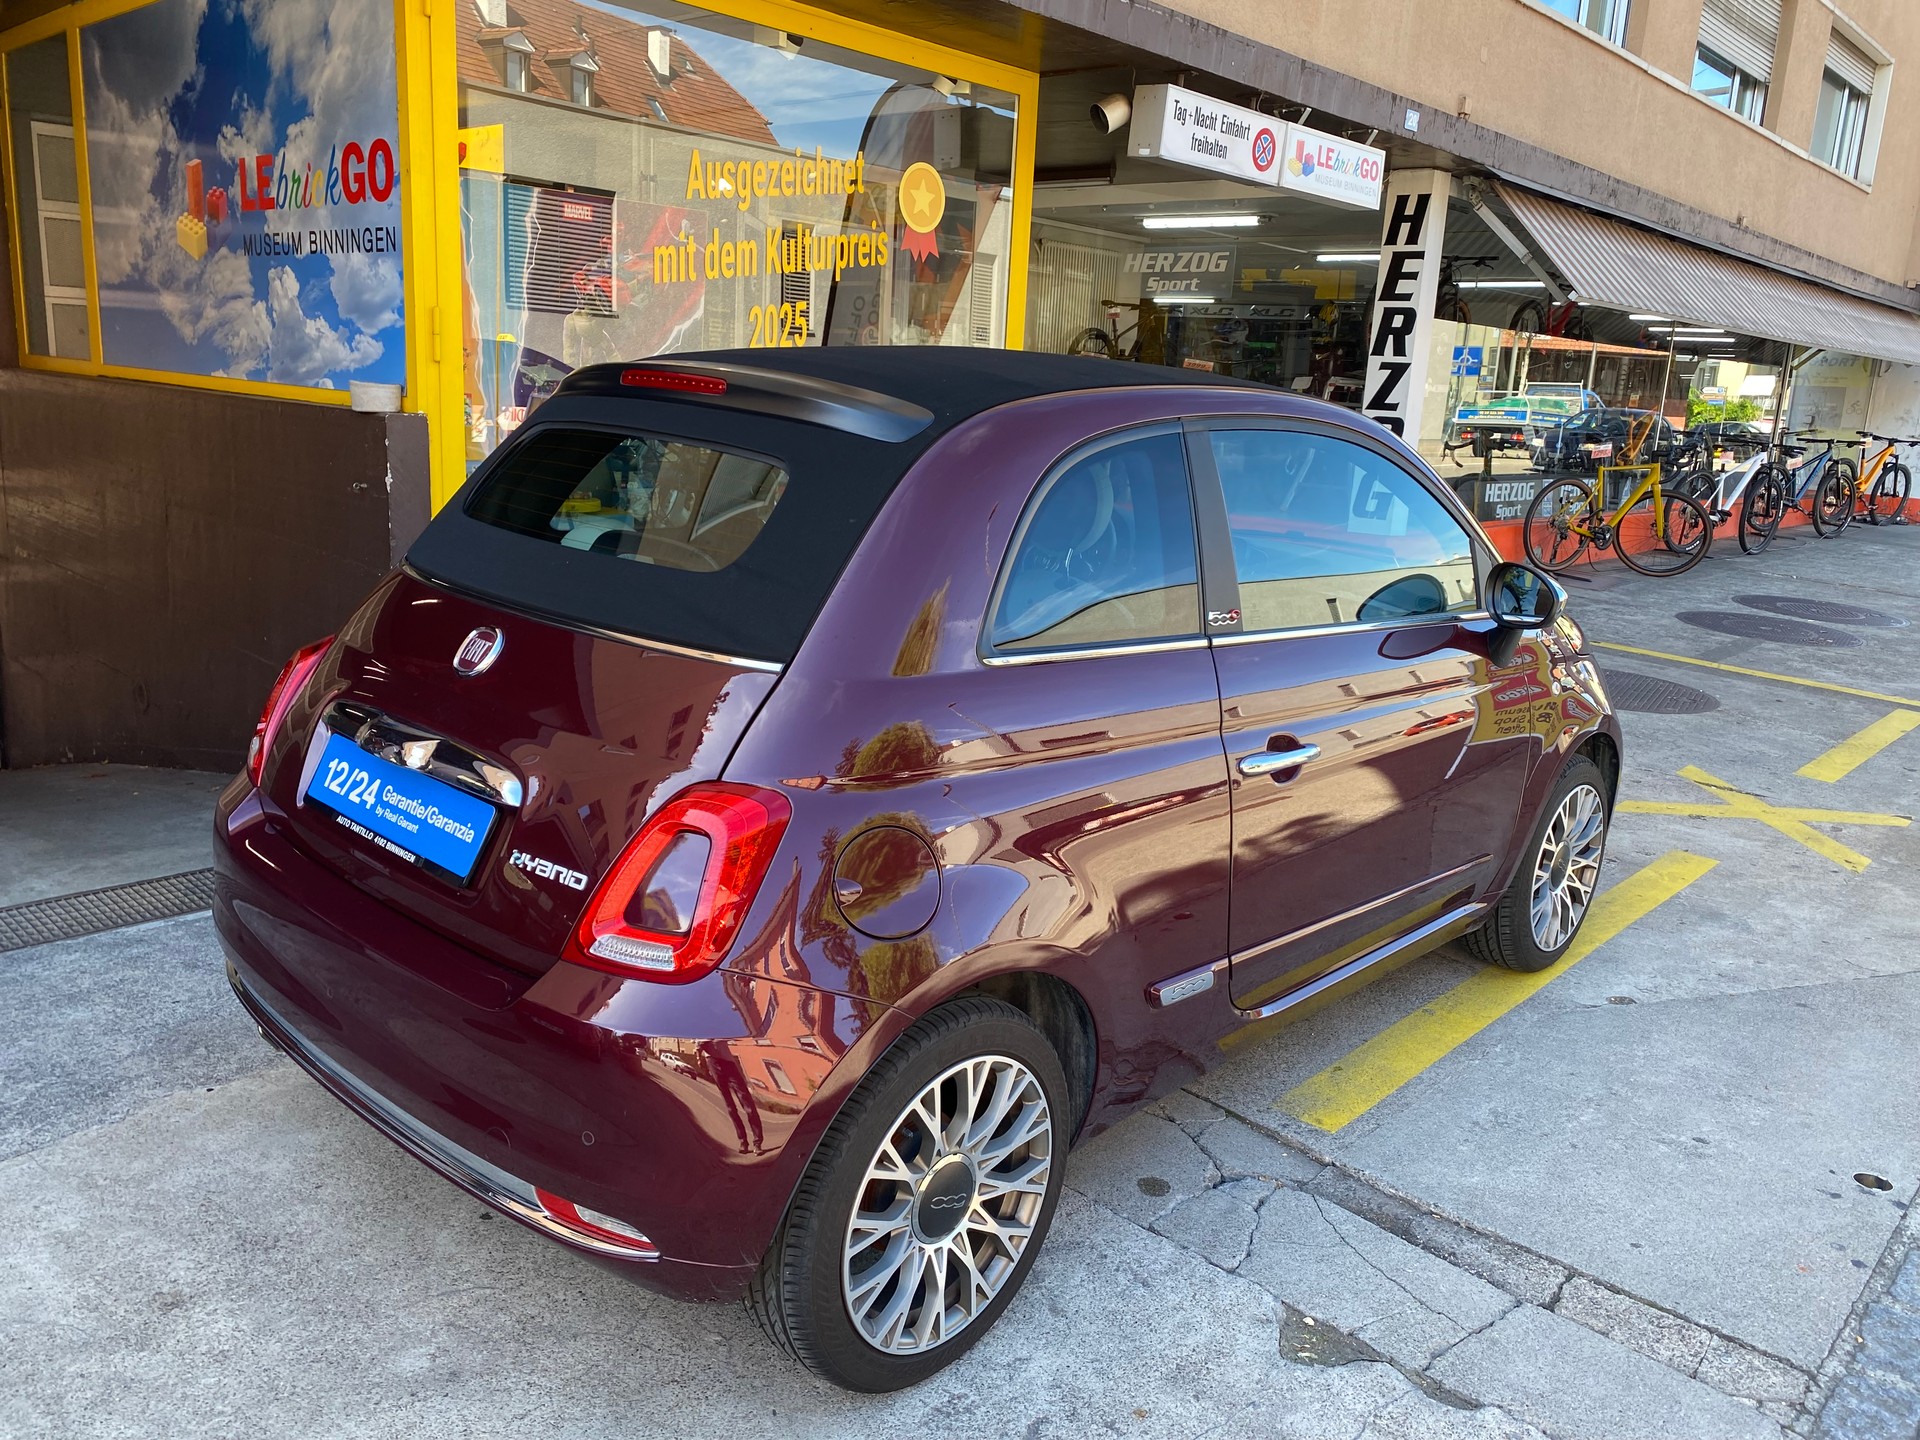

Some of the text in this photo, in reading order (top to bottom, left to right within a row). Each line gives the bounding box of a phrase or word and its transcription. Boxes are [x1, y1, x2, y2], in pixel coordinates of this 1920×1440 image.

[1173, 99, 1187, 126] Tag
[1193, 105, 1218, 131] Nacht
[1220, 114, 1251, 141] Einfahrt
[1190, 132, 1228, 160] freihalten
[238, 138, 394, 211] LEbrickGO
[1317, 144, 1379, 182] LEbrickGO
[686, 146, 865, 211] Ausgezeichnet
[1314, 173, 1376, 197] MUSEUM BINNINGEN
[564, 204, 592, 219] MARVEL
[243, 226, 397, 256] MUSEUM BINNINGEN
[654, 220, 888, 284] mit dem Kulturpreis
[1123, 251, 1230, 273] HERZOG
[1146, 277, 1200, 292] Sport
[749, 301, 807, 347] 2025
[1190, 307, 1234, 316] XLC
[1484, 482, 1535, 502] HERZOG
[1495, 504, 1522, 520] Sport
[461, 634, 493, 663] FIAT
[324, 758, 475, 844] 12/24 Garantie/Garanzia
[375, 804, 419, 834] by Real Garant
[336, 815, 351, 828] AUTO
[350, 821, 374, 840] TANTILLO
[385, 841, 416, 863] BINNINGEN
[509, 849, 588, 891] HYBRID
